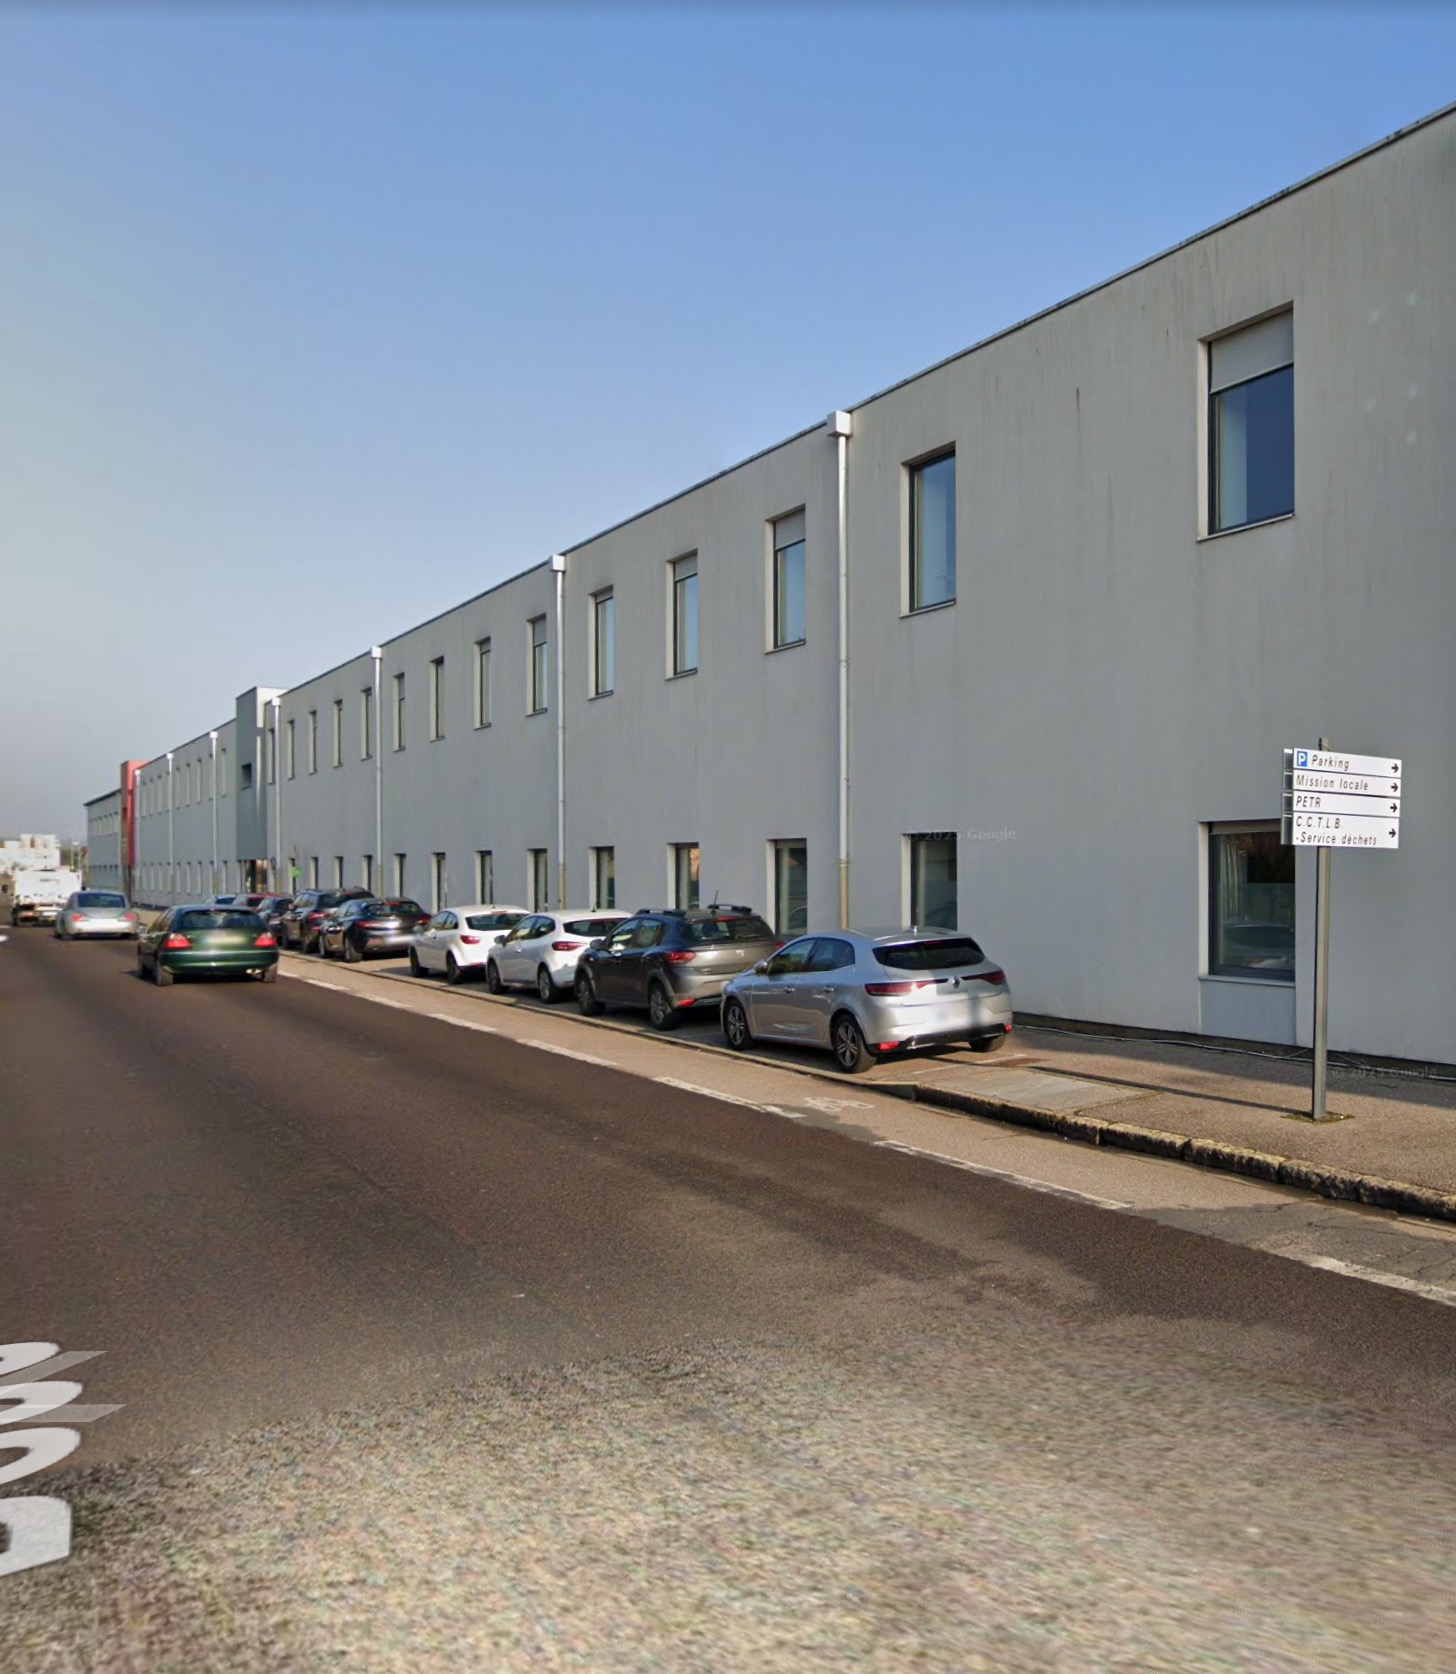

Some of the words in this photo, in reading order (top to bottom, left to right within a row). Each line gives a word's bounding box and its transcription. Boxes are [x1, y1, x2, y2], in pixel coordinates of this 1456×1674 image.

[1298, 752, 1306, 767] P
[1311, 754, 1350, 772] Parking
[1296, 774, 1335, 788] Mission
[1340, 778, 1369, 791] locale
[1296, 795, 1321, 808] PETR
[1341, 833, 1377, 846] déchets
